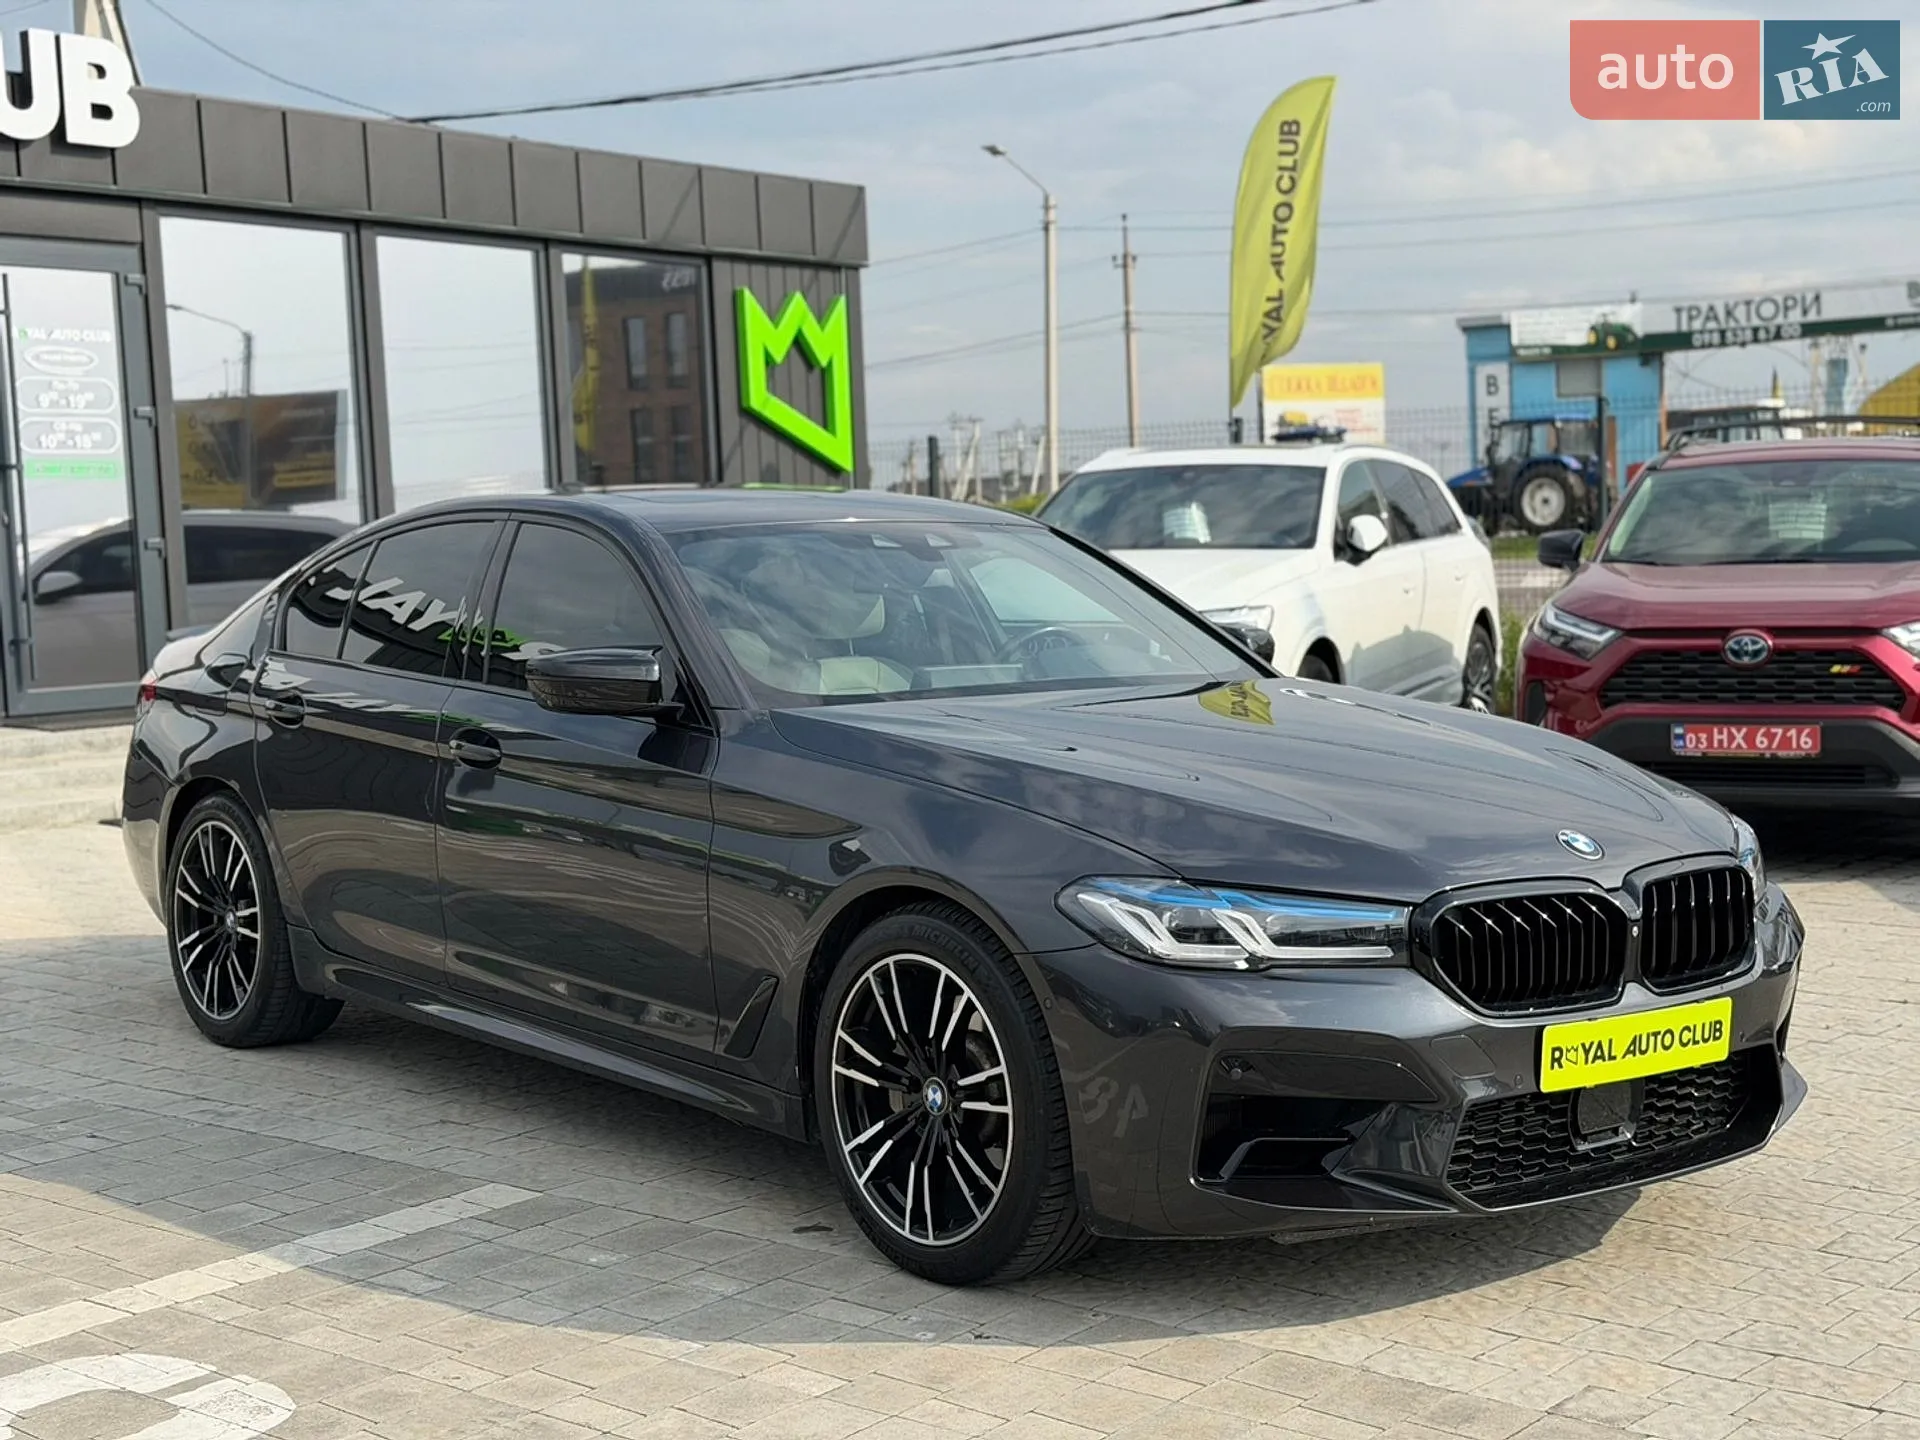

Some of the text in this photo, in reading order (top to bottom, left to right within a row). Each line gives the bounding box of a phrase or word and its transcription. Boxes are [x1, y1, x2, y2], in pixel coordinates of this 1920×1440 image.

[1276, 118, 1302, 196] CLUB
[1270, 202, 1295, 283] AUTO
[1673, 292, 1823, 332] ТРАКТОРИ
[1686, 733, 1708, 748] 03
[1713, 727, 1748, 749] HX
[1755, 727, 1813, 749] 6716
[1622, 1028, 1675, 1060] AUTO
[1679, 1019, 1723, 1048] CLUB
